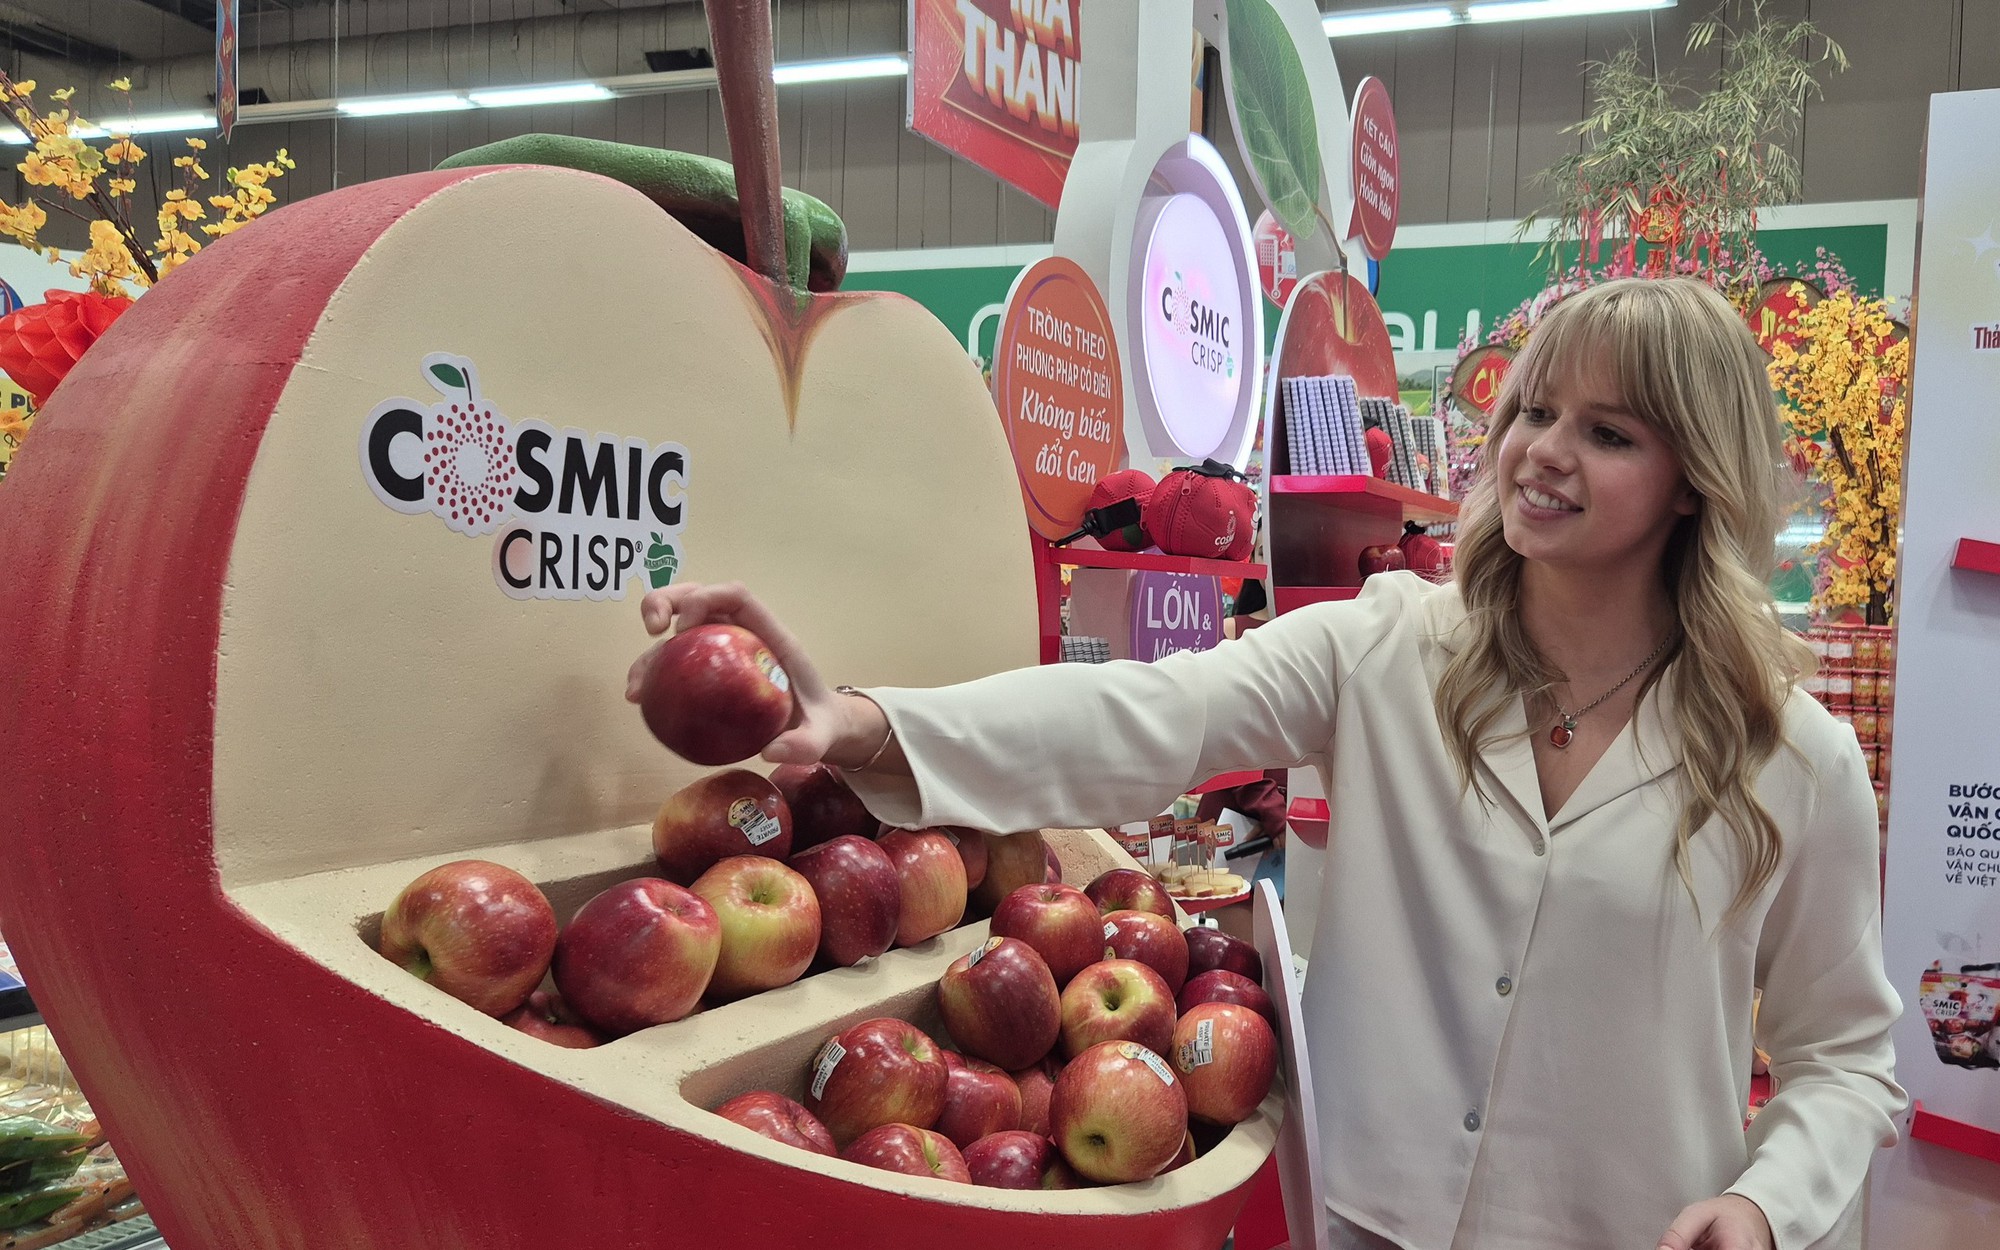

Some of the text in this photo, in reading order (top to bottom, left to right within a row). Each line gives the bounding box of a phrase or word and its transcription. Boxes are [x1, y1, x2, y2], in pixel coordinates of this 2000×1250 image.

[1377, 164, 1395, 193] ngon
[1027, 306, 1072, 349] TRỒNG
[1074, 325, 1106, 361] THEO
[1162, 287, 1230, 348] COSMIC
[1056, 355, 1079, 388] PHÁP
[1080, 360, 1092, 394] CỔ
[1020, 387, 1111, 444] Không biến
[368, 404, 684, 526] COSMIC
[1035, 438, 1097, 486] đổi Gen
[1147, 580, 1212, 631] LỚN &
[1176, 823, 1197, 832] COSMI
[1948, 802, 1989, 822] VẬN
[756, 825, 779, 841] PRIVATE
[1946, 859, 1973, 872] VẬN
[1947, 845, 1976, 858] BẢO
[1967, 874, 1997, 888] VIỆT
